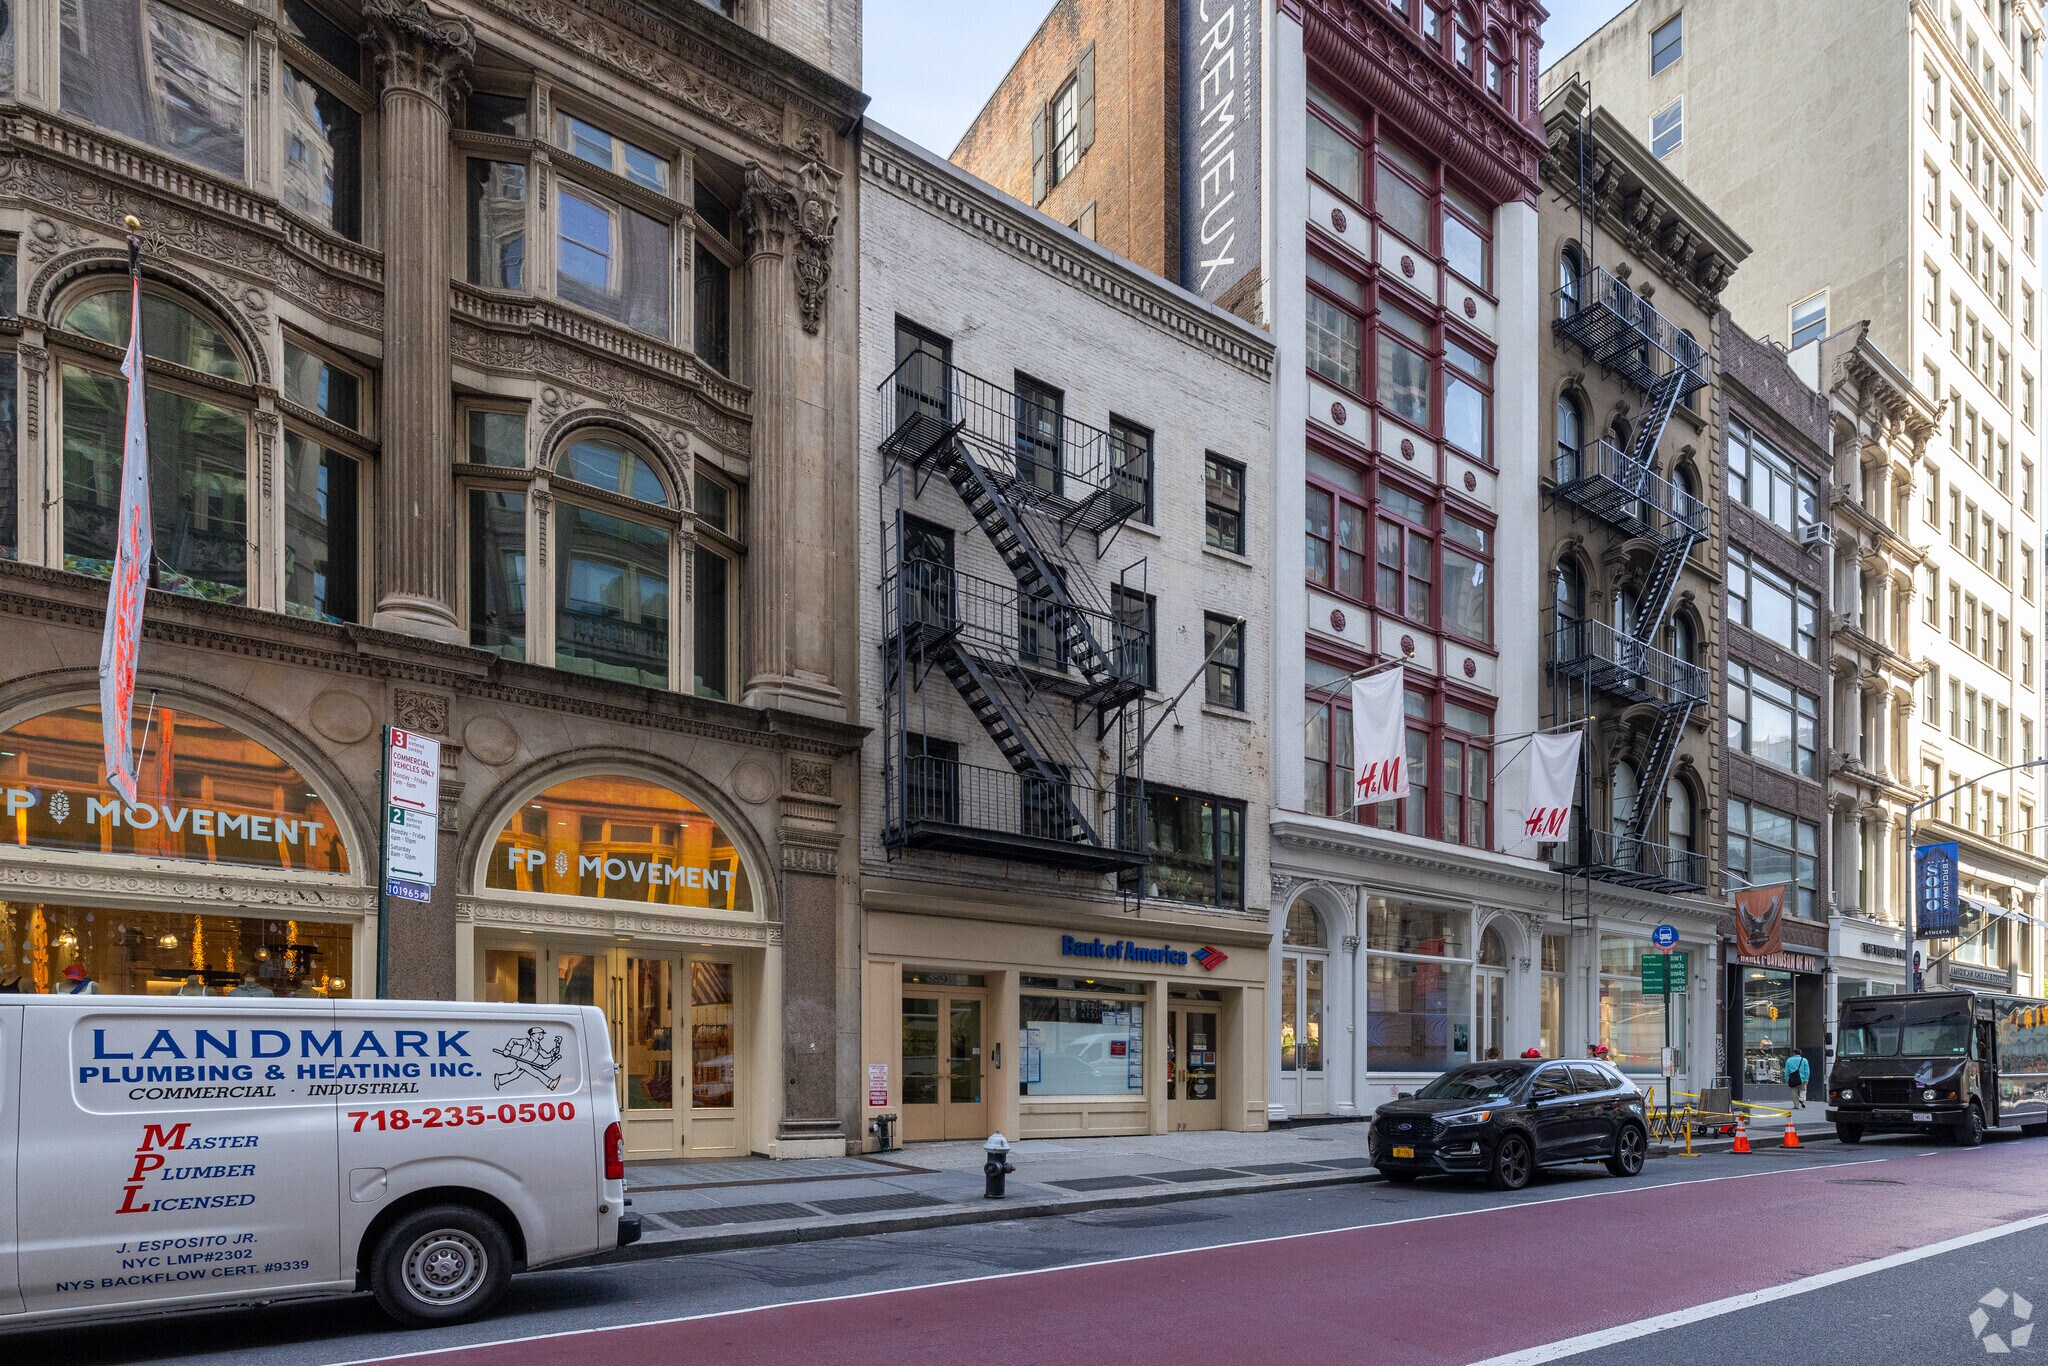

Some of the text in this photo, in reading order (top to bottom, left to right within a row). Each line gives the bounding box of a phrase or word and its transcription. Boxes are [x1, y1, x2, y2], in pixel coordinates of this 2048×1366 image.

[1200, 0, 1234, 291] REMIEUX
[395, 732, 404, 746] 3
[393, 752, 430, 768] COMMERCIAL
[393, 760, 434, 778] VEHICLES ONLY
[392, 771, 410, 780] Monday
[414, 776, 428, 786] Friday
[1356, 756, 1400, 798] H&M
[0, 788, 324, 847] P MOVEMENT
[393, 808, 401, 823] 2
[1524, 807, 1568, 838] H&M
[391, 827, 408, 837] Monday
[412, 831, 426, 840] Friday
[391, 844, 411, 853] Saturday
[508, 848, 736, 891] FP MOVEMENT
[389, 885, 419, 898] 101965
[1926, 864, 1940, 910] SOHO
[1062, 934, 1188, 965] Bank of America
[1796, 954, 1803, 970] OF
[1804, 956, 1816, 971] NYC
[92, 1029, 472, 1060] LANDMARK
[80, 1062, 482, 1083] PLUMBING & HEATING INC.
[128, 1086, 276, 1100] COMMERCIAL
[307, 1083, 419, 1096] INDUSTRIAL
[347, 1101, 576, 1133] 718-235-0500
[136, 1123, 259, 1152] MASTER
[127, 1154, 256, 1182] PLUMBER
[115, 1184, 256, 1214] LICENSED
[116, 1233, 258, 1254] J. ESPOSITO JR.
[122, 1248, 253, 1269] NYC LMP#2302
[56, 1259, 310, 1292] NYS BACKFLOW CERT. #9339
